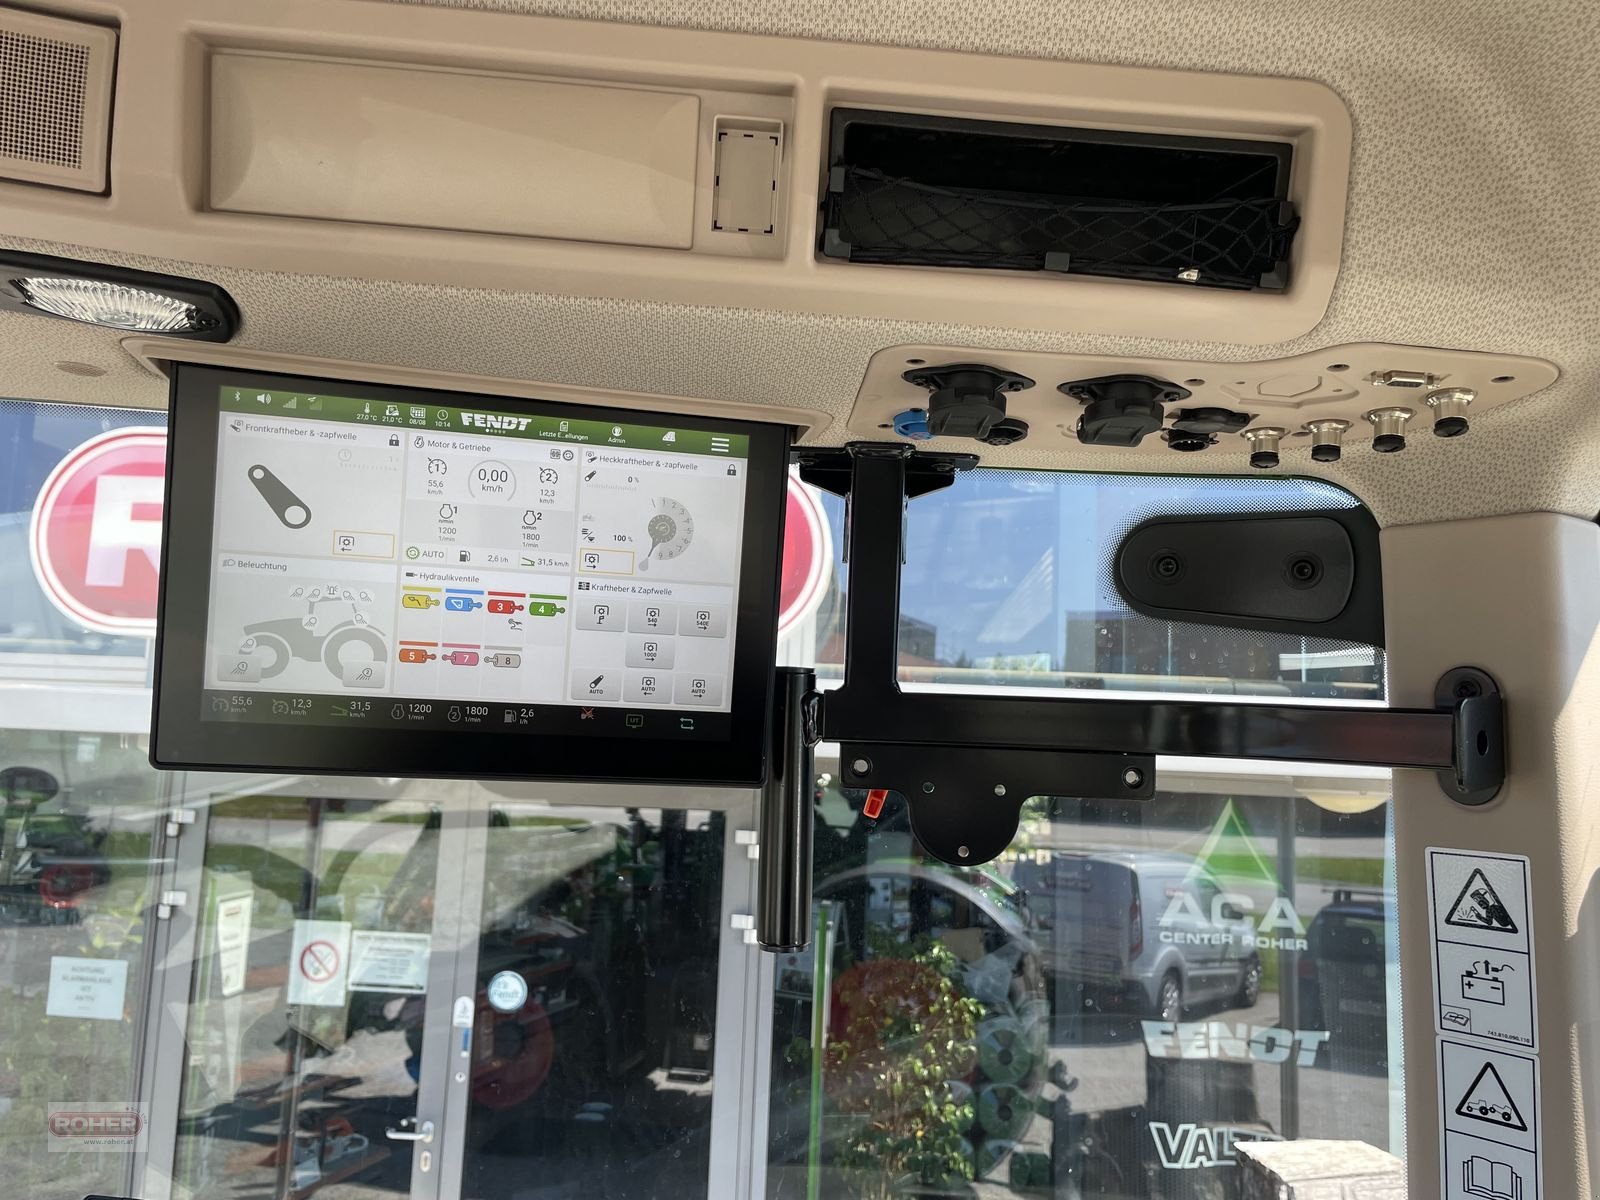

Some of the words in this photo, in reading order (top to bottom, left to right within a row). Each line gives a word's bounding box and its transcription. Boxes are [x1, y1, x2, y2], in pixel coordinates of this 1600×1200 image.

[460, 411, 533, 432] FENDT
[245, 424, 308, 437] Frontkraftheber
[316, 432, 357, 441] -zapfwelle
[539, 430, 556, 439] Letzte
[427, 440, 450, 449] Motor
[459, 443, 491, 452] Getriebe
[599, 456, 654, 467] Heckkraftheber
[661, 462, 698, 471] -zapfwelle
[478, 468, 508, 483] 0,00
[427, 479, 444, 488] 55,6
[481, 484, 503, 493] km/h
[540, 489, 555, 497] 12,3
[438, 527, 457, 535] 1200
[522, 533, 540, 541] 1800
[613, 534, 627, 542] 100
[421, 550, 445, 559] AUTO
[487, 554, 499, 563] 2,6
[237, 561, 288, 572] Beleuchtung
[537, 558, 553, 567] 31,5
[419, 572, 480, 583] Hydraulikventile
[591, 583, 630, 593] Kraftheber
[637, 586, 673, 596] Zapfwelle
[497, 603, 503, 611] 3
[538, 605, 545, 613] 4
[409, 652, 415, 660] 5
[463, 654, 469, 662] 7
[505, 657, 510, 665] 8
[232, 696, 253, 706] 55,6
[292, 699, 312, 708] 12,3
[350, 701, 371, 711] 31,5
[408, 704, 432, 713] 1200
[465, 706, 488, 715] 1800
[520, 708, 535, 718] 2,6
[1158, 891, 1307, 935] ACA
[1159, 931, 1233, 945] CENTER
[1241, 935, 1309, 951] ROHER
[1140, 1020, 1331, 1067] FENDT
